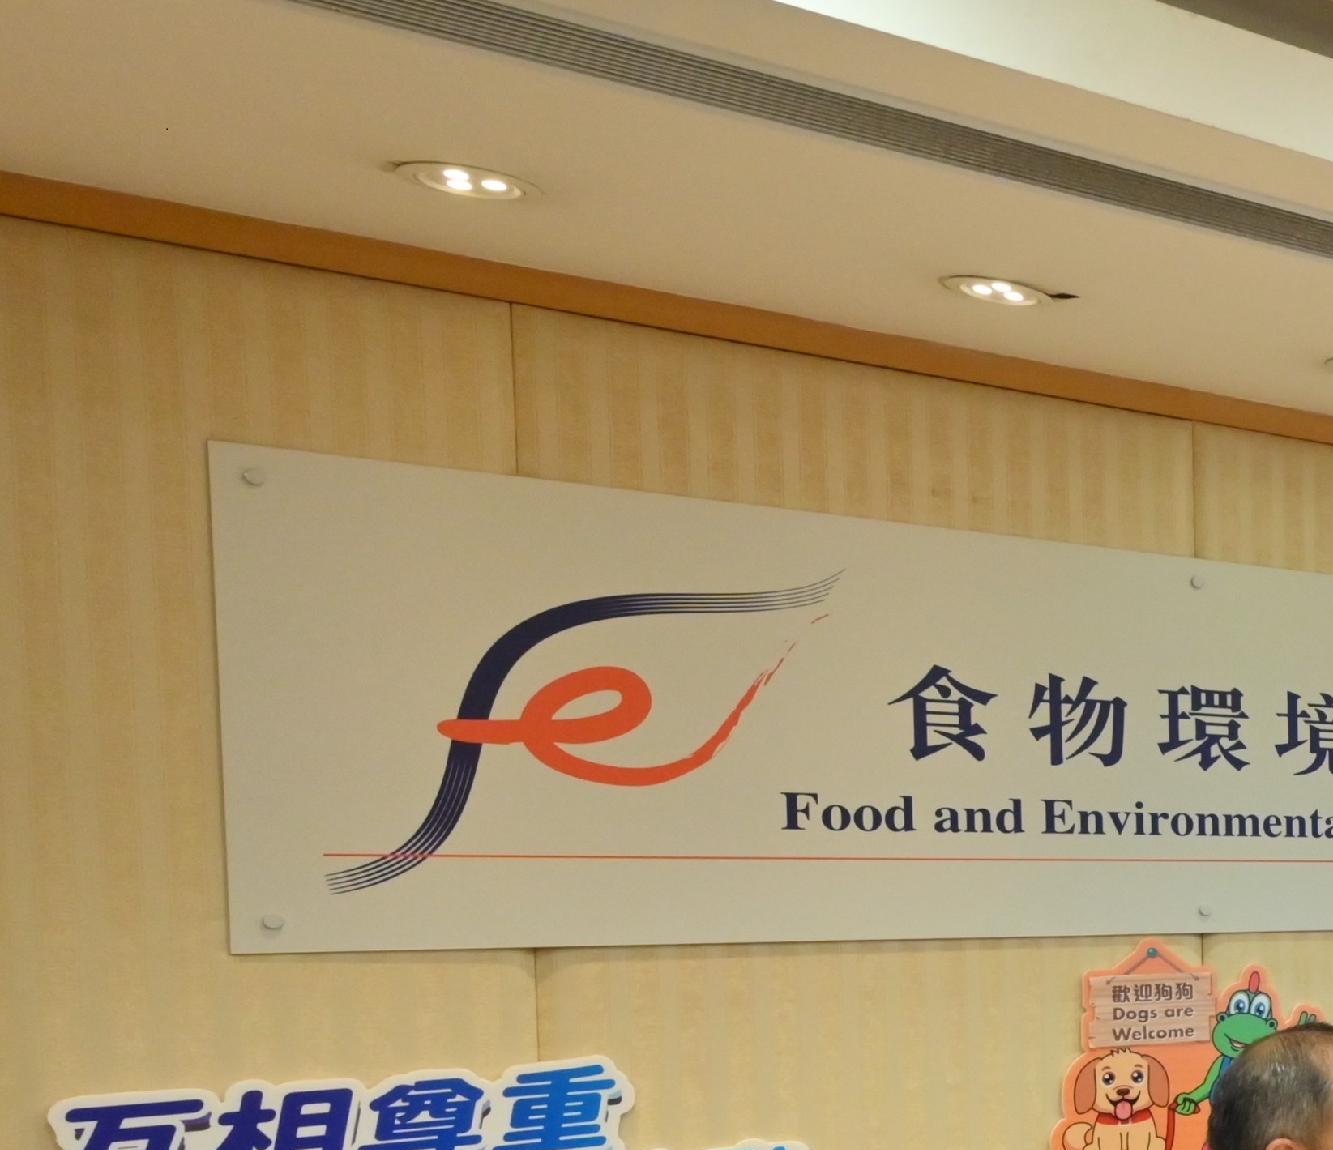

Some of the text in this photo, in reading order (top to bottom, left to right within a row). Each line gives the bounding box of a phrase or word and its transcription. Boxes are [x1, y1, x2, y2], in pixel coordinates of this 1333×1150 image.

[780, 791, 913, 835] Food
[933, 798, 1025, 836] and
[1112, 983, 1193, 1003] 歡迎狗狗
[1112, 1007, 1194, 1023] Dogs are
[1112, 1025, 1194, 1041] Welcome
